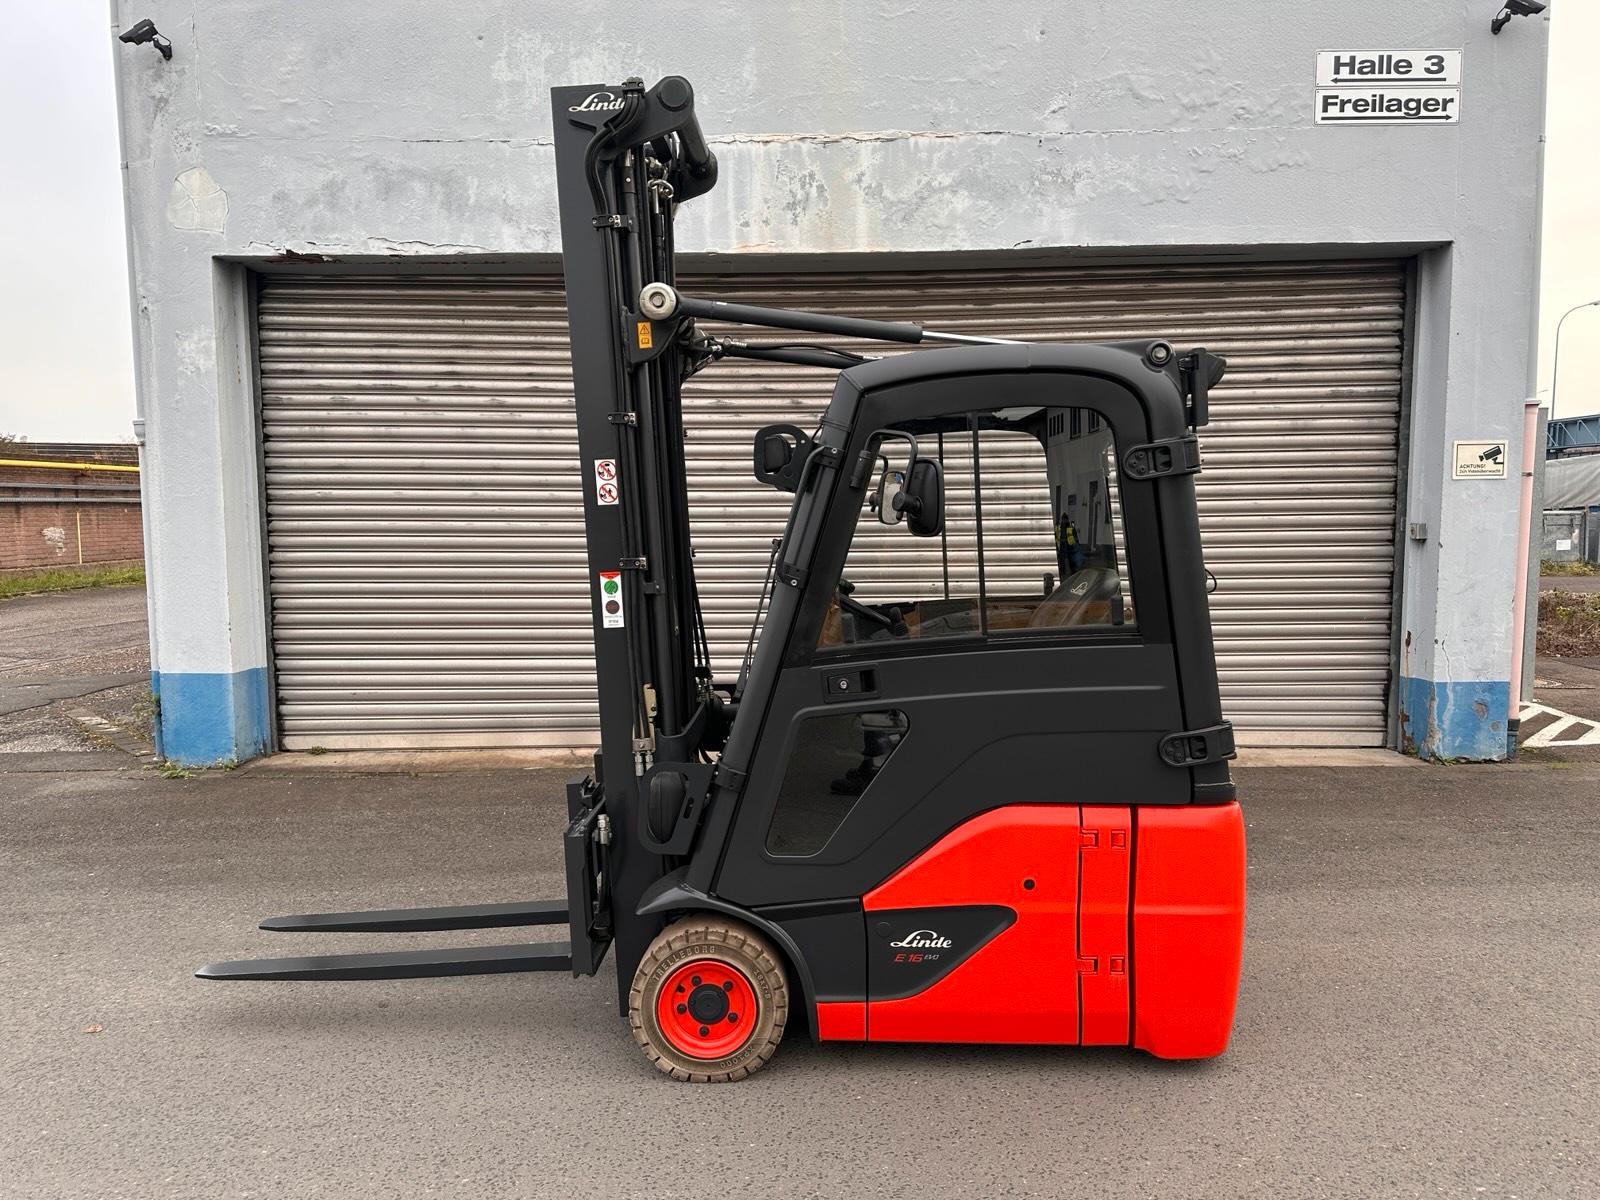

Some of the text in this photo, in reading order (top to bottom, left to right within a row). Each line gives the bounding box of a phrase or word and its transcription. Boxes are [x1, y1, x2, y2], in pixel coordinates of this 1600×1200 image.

[1333, 55, 1445, 75] Halle 3
[1322, 94, 1454, 117] Freilager
[890, 930, 952, 948] Linde
[653, 945, 715, 981] TRELLEBORG
[894, 953, 906, 963] E
[908, 953, 923, 963] 16
